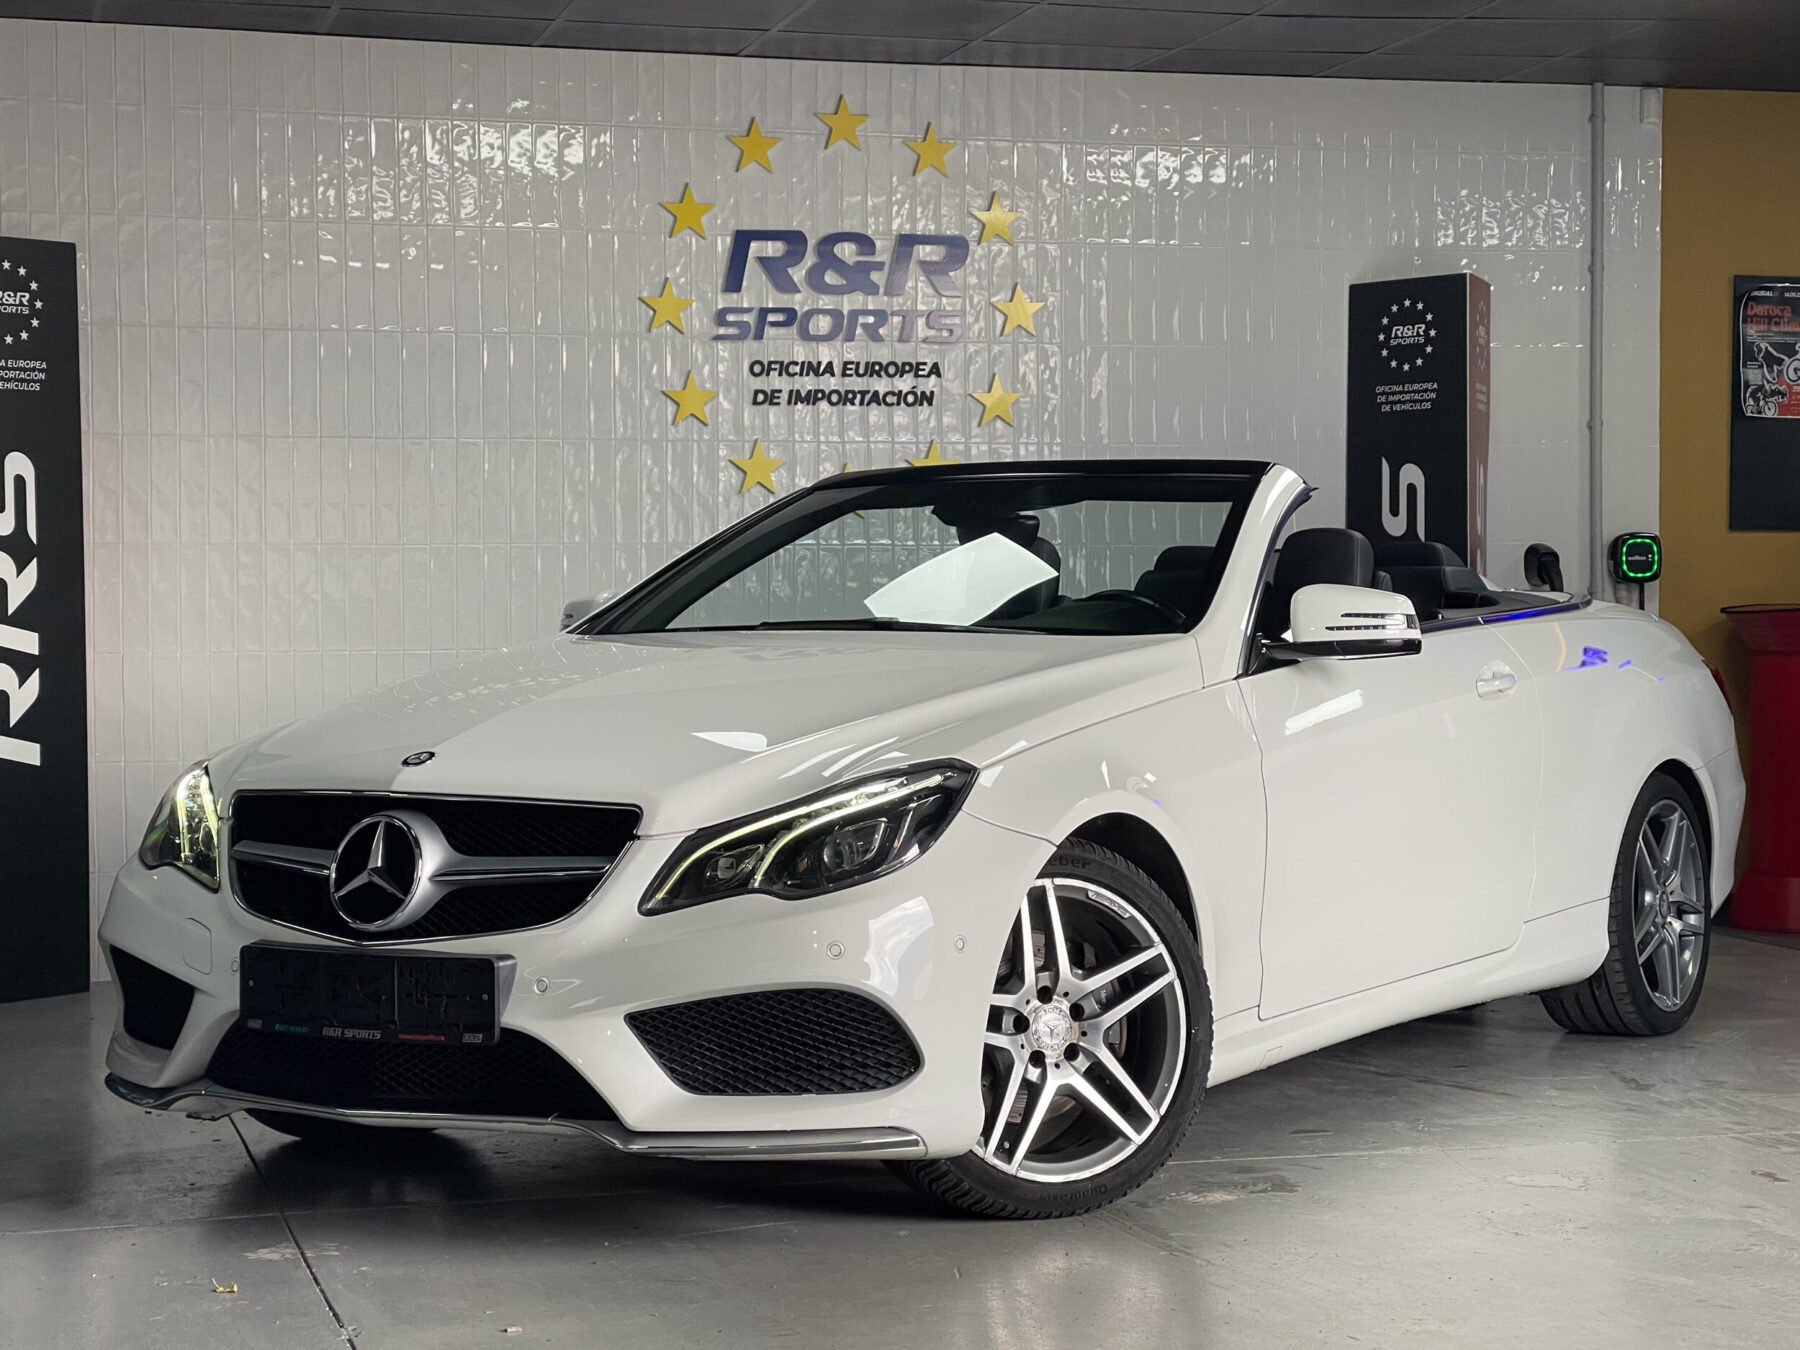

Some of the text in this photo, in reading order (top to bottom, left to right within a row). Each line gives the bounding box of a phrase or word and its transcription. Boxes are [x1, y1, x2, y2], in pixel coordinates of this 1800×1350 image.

[721, 229, 970, 298] R&R
[0, 290, 30, 306] &R
[0, 305, 30, 314] ORTS
[711, 306, 965, 344] SPORTS
[1391, 324, 1426, 338] R&R
[1390, 336, 1425, 346] SPORTS
[7, 359, 47, 369] EUROPEA
[748, 359, 943, 379] OFICINA EUROPEA
[0, 380, 41, 391] EHÍCULOS
[1375, 382, 1438, 393] OFICINA EUROPEA
[752, 386, 935, 408] DE IMPORTACIÓN
[1377, 391, 1437, 403] DE IMPORTACIÓN
[1381, 401, 1432, 412] DE VEHÍCULOS
[343, 1028, 382, 1040] SPORTS
